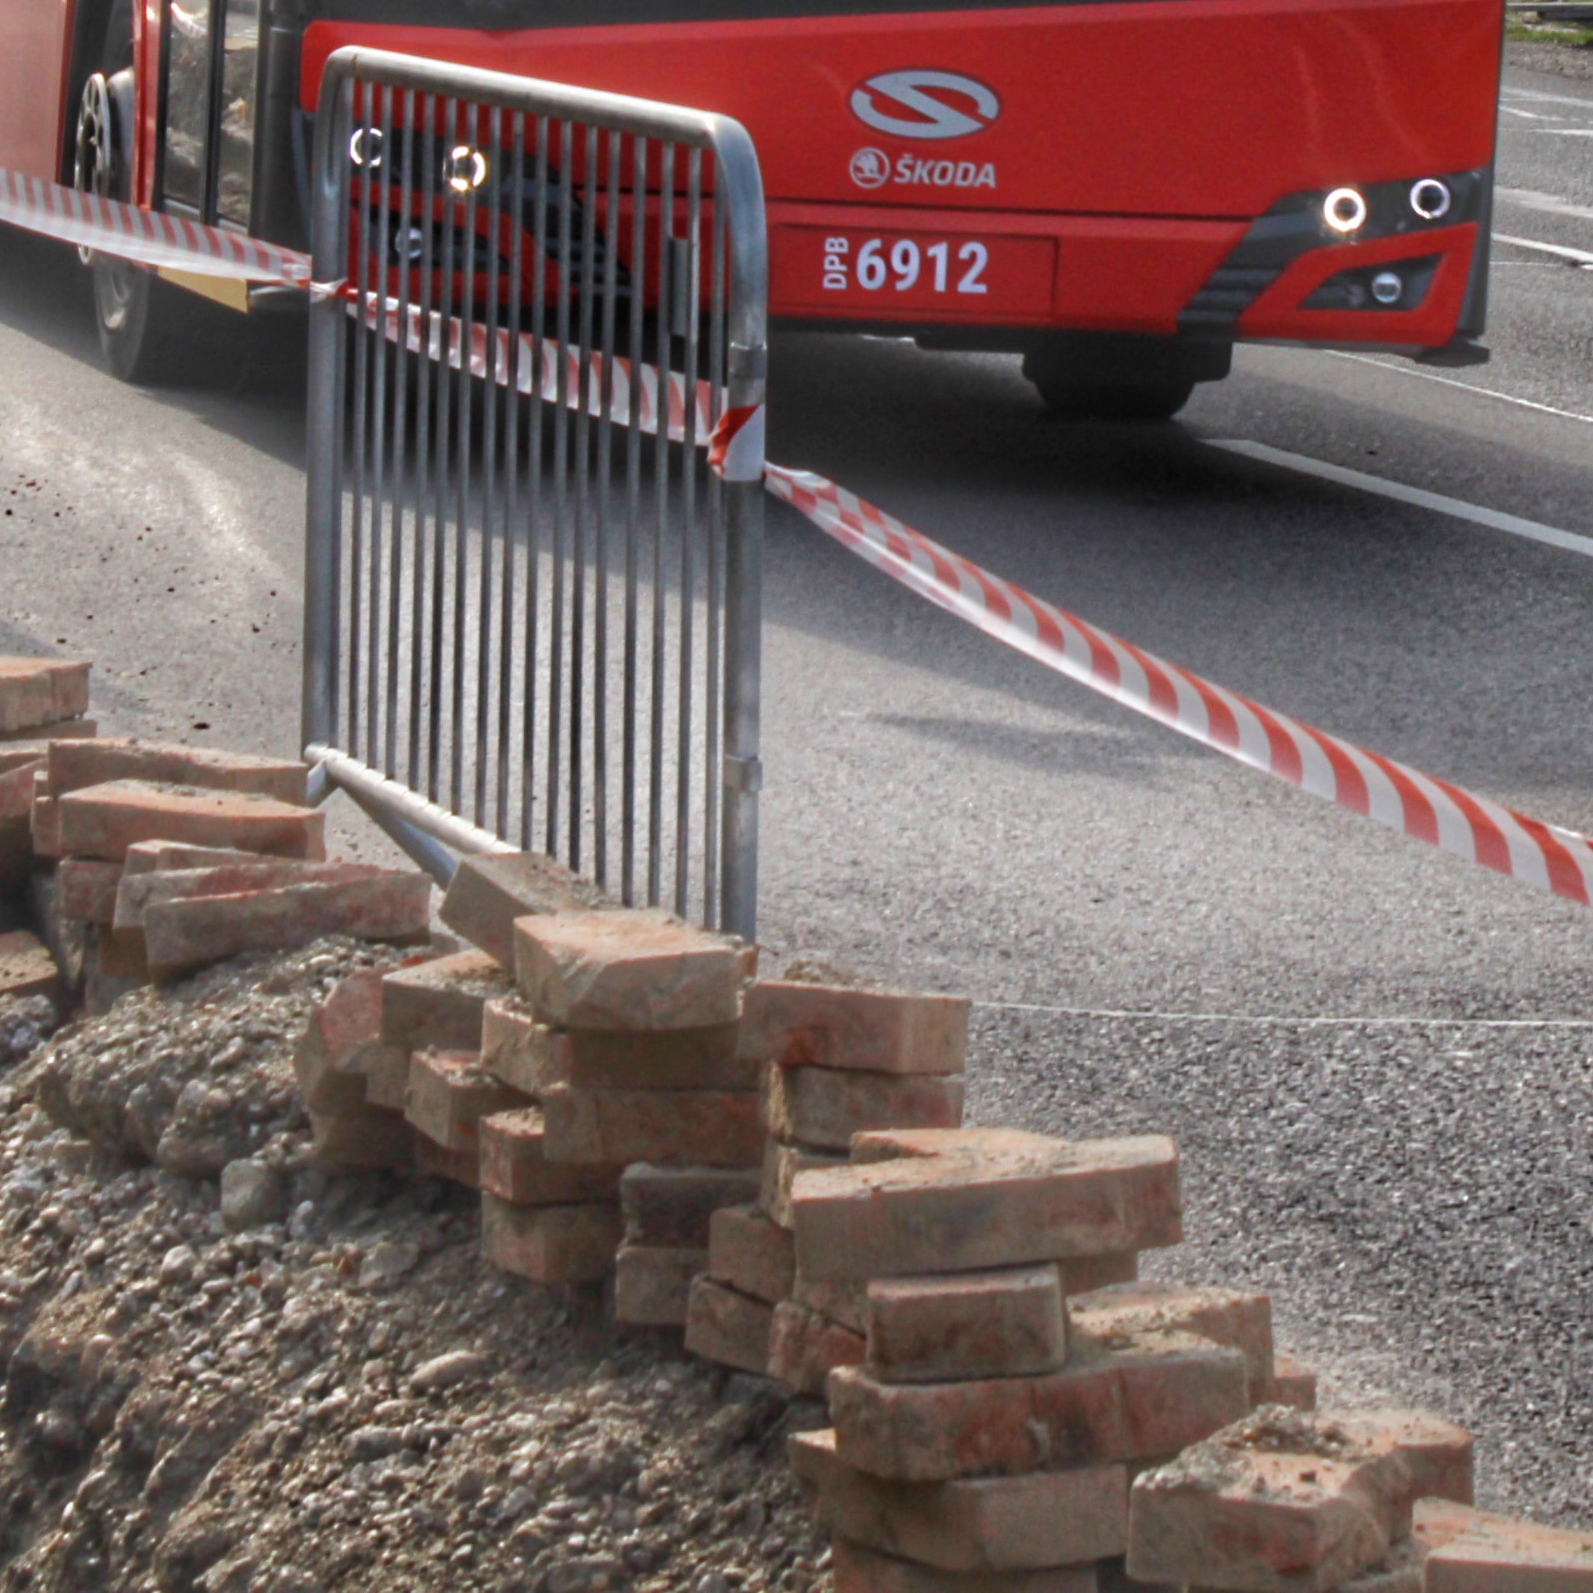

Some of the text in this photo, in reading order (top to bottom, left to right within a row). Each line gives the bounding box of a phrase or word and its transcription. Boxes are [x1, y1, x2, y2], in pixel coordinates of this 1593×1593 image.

[894, 153, 996, 188] ŠKODA
[822, 236, 988, 294] DPB 6912
